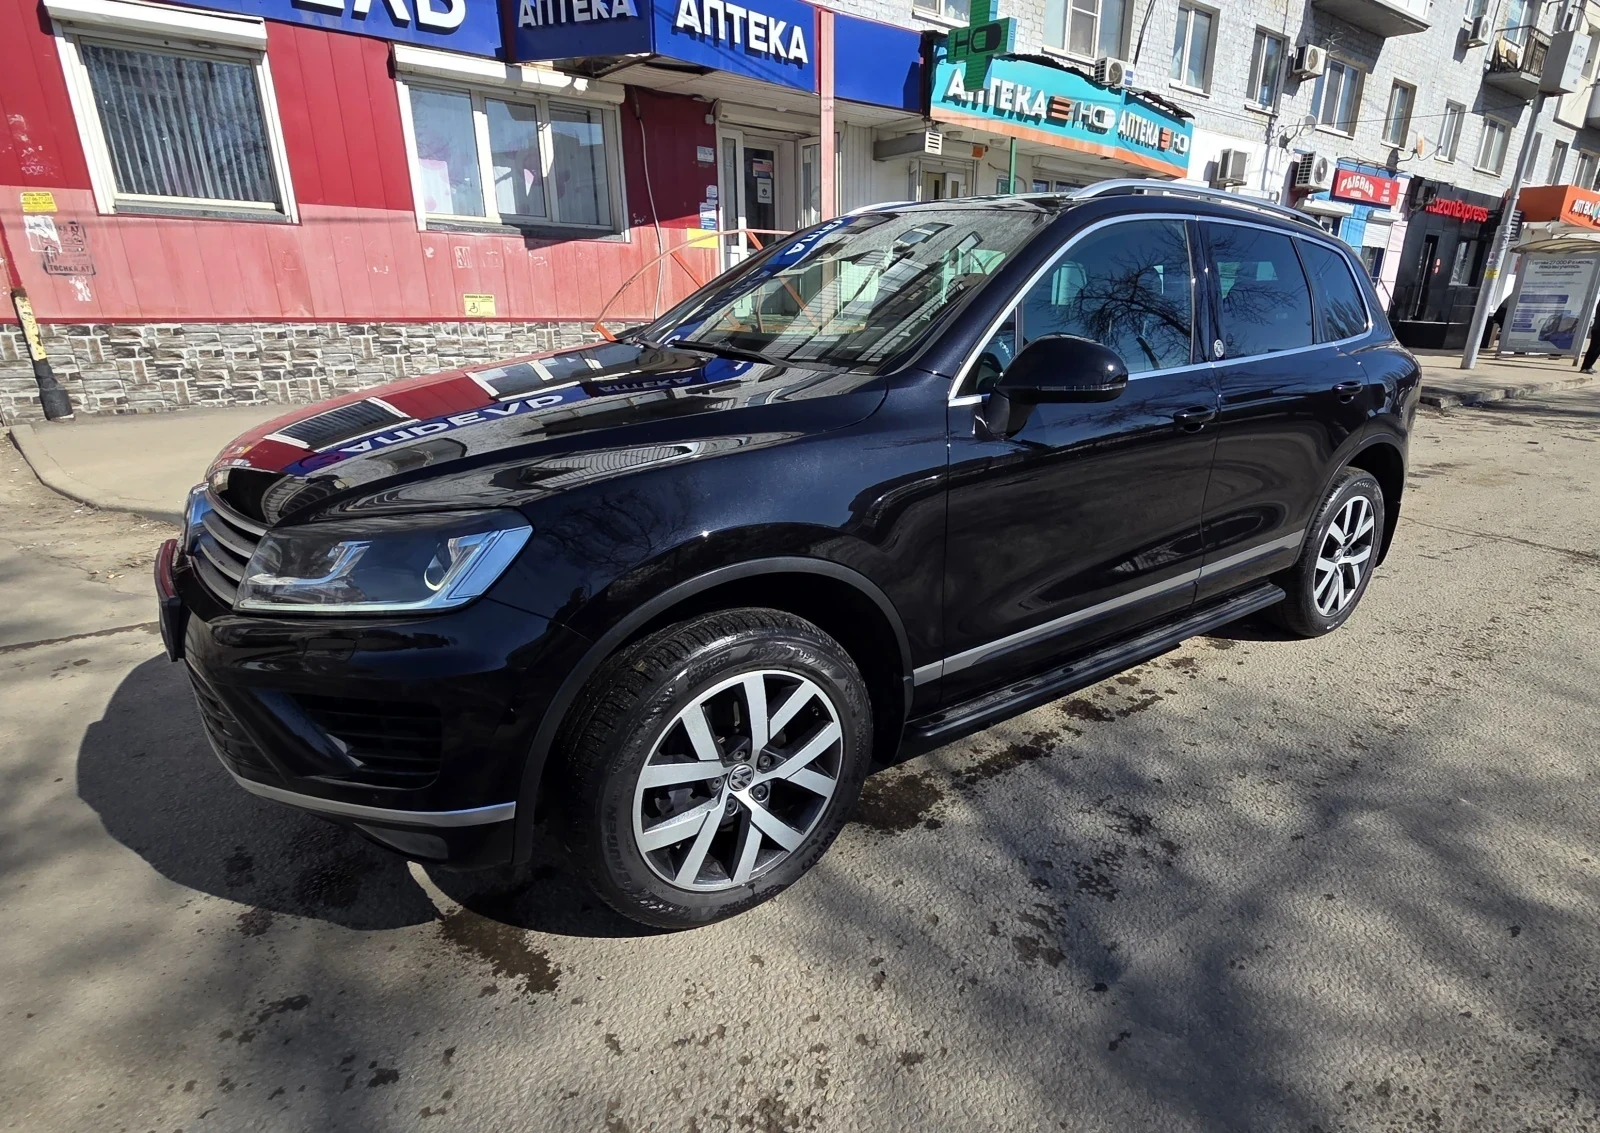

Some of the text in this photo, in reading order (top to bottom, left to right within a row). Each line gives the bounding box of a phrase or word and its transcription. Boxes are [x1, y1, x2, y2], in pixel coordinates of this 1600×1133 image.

[518, 0, 638, 28] АПТЕКА
[676, 0, 808, 64] АПТЕКА
[1117, 111, 1160, 147] АПТЕКА
[1340, 175, 1374, 198] РЫБНАЯ
